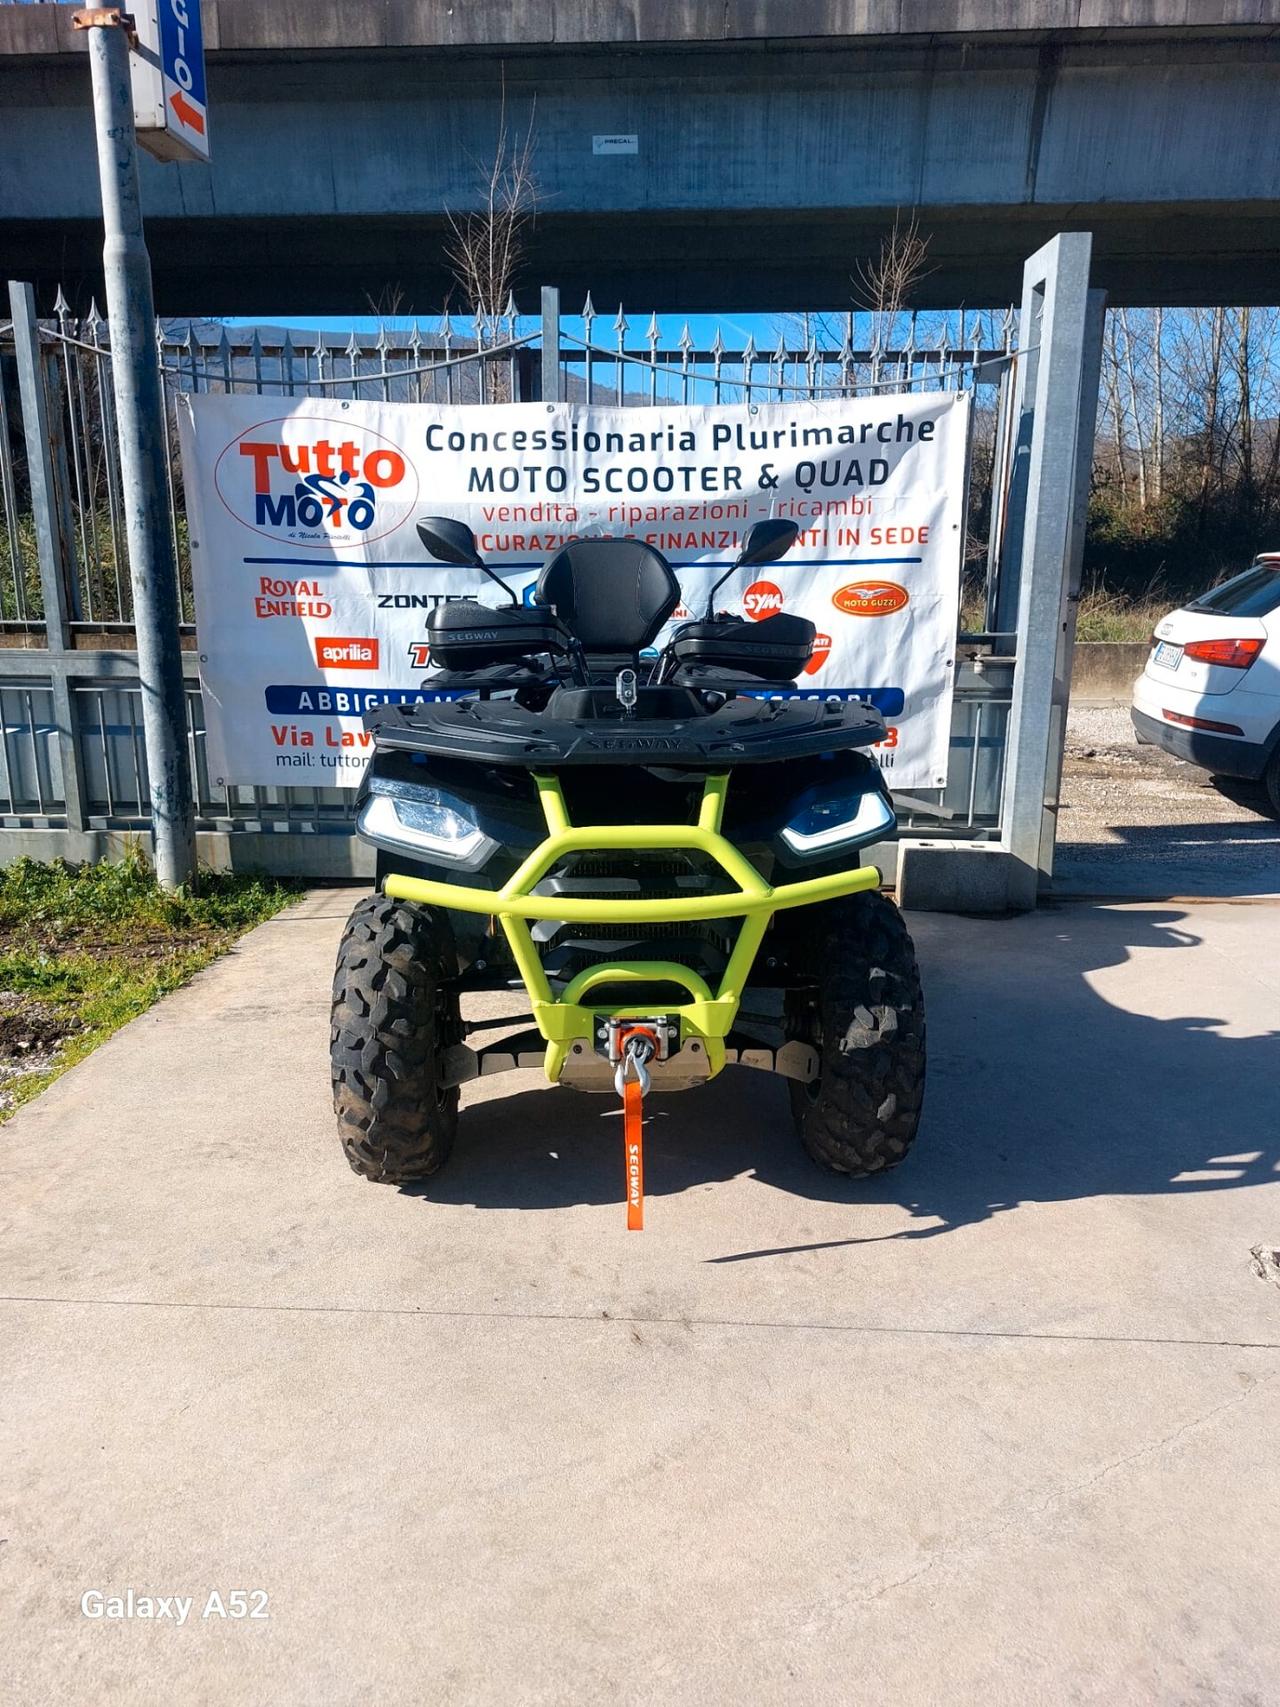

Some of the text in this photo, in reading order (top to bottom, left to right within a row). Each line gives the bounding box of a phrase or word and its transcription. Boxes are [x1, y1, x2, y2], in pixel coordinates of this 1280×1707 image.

[425, 414, 935, 452] Concessionaria Plurimarche
[467, 458, 889, 494] MOTO SCOOTER & QUAD
[482, 502, 578, 523] vendita
[608, 500, 747, 528] riparazioni
[778, 494, 872, 518] ricambi
[646, 528, 828, 551] FINANZINTI
[838, 528, 861, 546] IN
[870, 525, 930, 546] SEDE
[259, 576, 323, 597] ROYAL
[255, 597, 333, 619] ENFIELD
[744, 592, 784, 614] SYM
[843, 598, 897, 608] MOTO GUZZI
[448, 631, 498, 641] SEGWAY
[322, 642, 373, 663] aprilia
[271, 725, 315, 747] Via
[275, 752, 315, 768] mail:
[629, 1144, 639, 1208] SEGWAY
